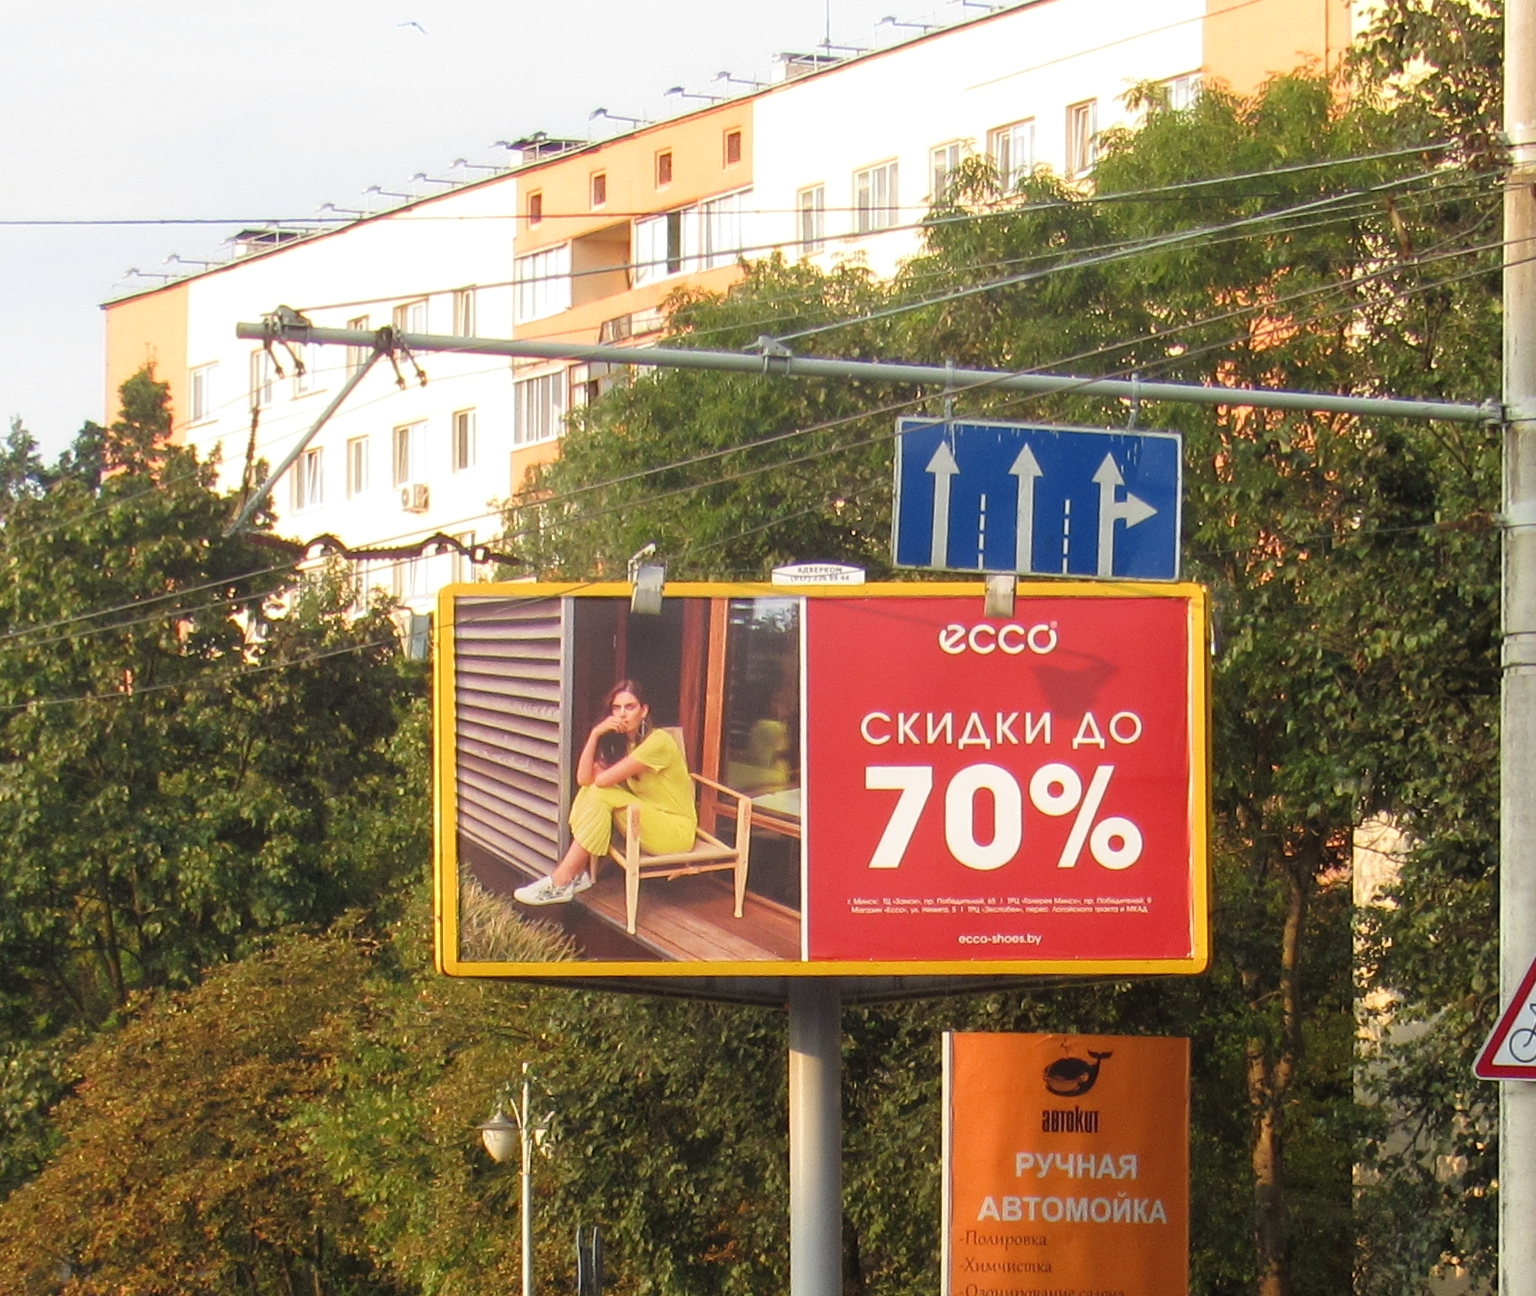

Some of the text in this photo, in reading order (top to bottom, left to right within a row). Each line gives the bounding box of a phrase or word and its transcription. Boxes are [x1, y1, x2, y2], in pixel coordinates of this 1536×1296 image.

[938, 623, 1057, 655] ecco
[860, 711, 1143, 750] СКИДКИ ДО
[864, 762, 1144, 870] 70%
[957, 933, 1042, 946] ecco-shoes.by
[1015, 1151, 1139, 1180] РУЧНАЯ
[976, 1191, 1168, 1224] АВТОМОЙКА
